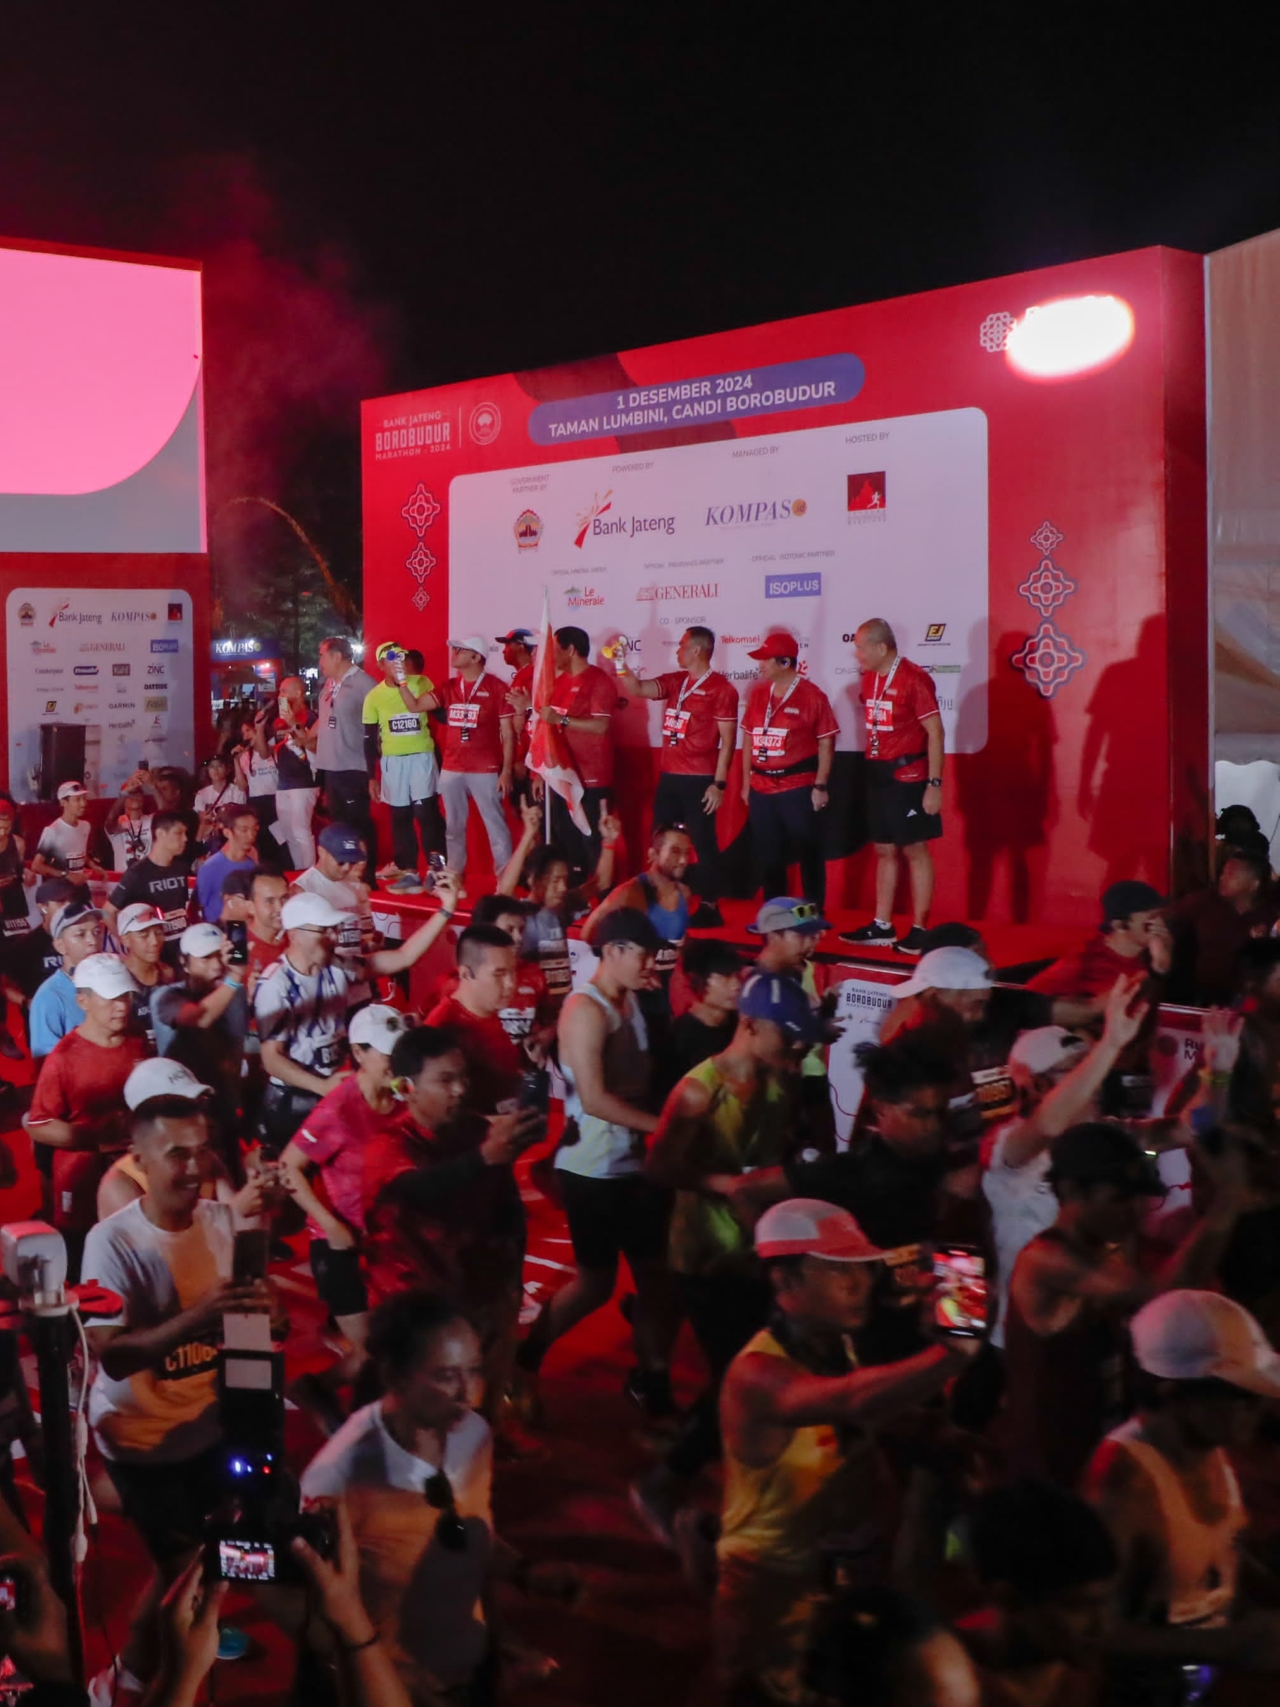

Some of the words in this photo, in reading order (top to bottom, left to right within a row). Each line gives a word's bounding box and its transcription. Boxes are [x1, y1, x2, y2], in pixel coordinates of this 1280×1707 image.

[617, 395, 625, 410] 1
[629, 381, 711, 408] DESEMBER
[716, 374, 753, 394] 2024
[549, 418, 599, 438] TAMAN
[603, 410, 668, 431] LUMBINI,
[672, 401, 722, 420] CANDI
[726, 381, 836, 412] BOROBUDUR
[383, 415, 407, 429] BANK
[409, 411, 441, 427] JATENG
[375, 422, 451, 452] BOROBUDUR
[845, 433, 878, 445] HOSTED
[879, 431, 890, 441] BY
[375, 448, 421, 461] MARATHON
[430, 443, 451, 454] 2024
[732, 447, 769, 459] MANAGED
[770, 446, 779, 455] BY
[612, 463, 645, 474] POWERED
[645, 462, 654, 470] BY
[705, 500, 792, 526] KOMPAS
[593, 517, 627, 536] Bank
[629, 516, 676, 538] Jateng
[584, 586, 595, 597] Le
[655, 583, 720, 600] GENERALI
[769, 580, 819, 595] ISOPLUS
[568, 597, 605, 607] Minerale
[59, 612, 78, 622] Bank
[79, 613, 102, 624] Jateng
[721, 634, 760, 644] Telkomsel
[216, 642, 254, 653] KOMPAS
[392, 719, 417, 730] C12160
[149, 876, 185, 893] RIOT
[846, 993, 892, 1009] BOROBUDUR
